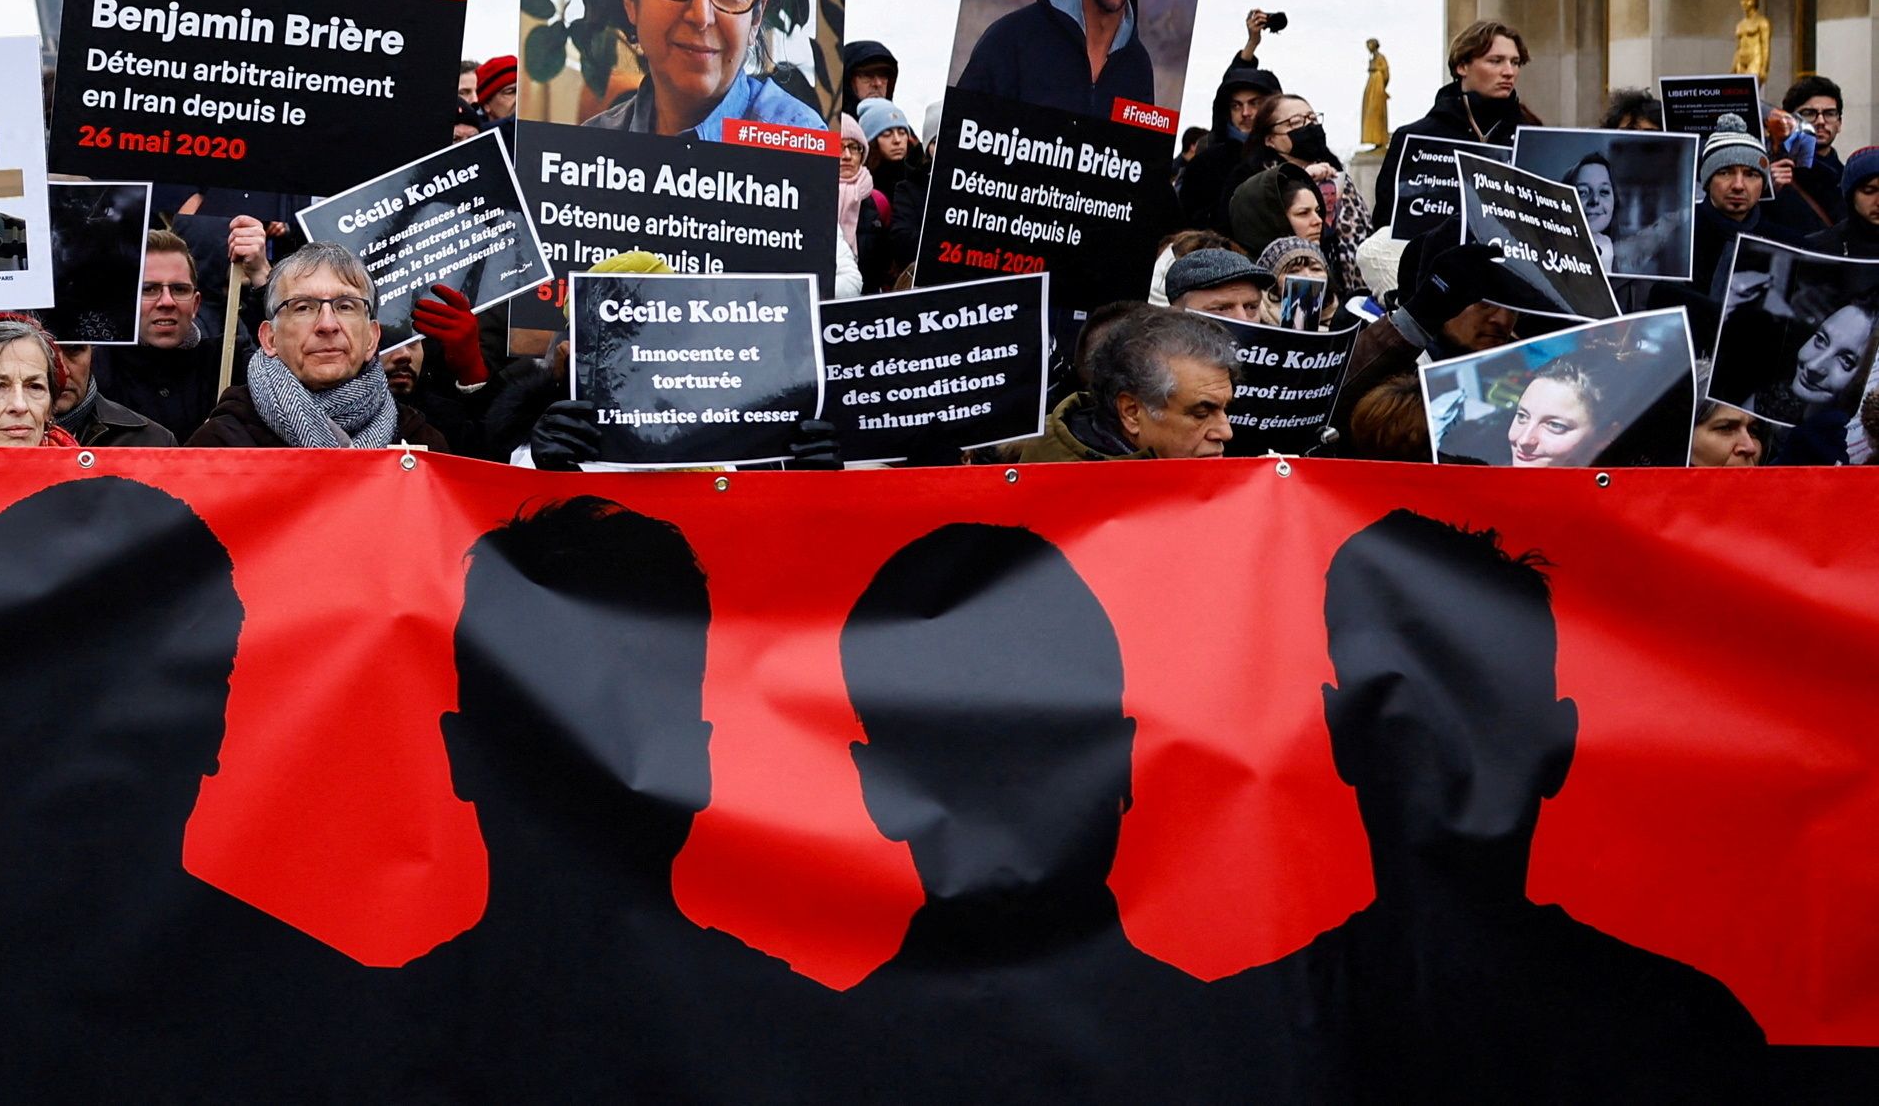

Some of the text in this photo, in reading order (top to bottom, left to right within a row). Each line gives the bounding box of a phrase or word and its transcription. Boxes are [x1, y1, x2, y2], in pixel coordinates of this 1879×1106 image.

[285, 14, 404, 54] Brière
[87, 49, 395, 98] Détenu arbitrairement
[83, 88, 305, 125] en Iran depuis le
[1123, 106, 1169, 128] #FreeBen
[80, 126, 246, 159] 26 mai 2020
[739, 126, 825, 151] #FreeFariba
[959, 119, 1141, 182] Benjamin Brière
[1412, 149, 1456, 163] Innocen
[542, 152, 798, 209] Fariba Adelkhah
[951, 168, 1132, 221] Détenu arbitrairement
[1408, 174, 1459, 187] L'injustic
[1473, 173, 1501, 190] Plus
[1504, 181, 1514, 194] de
[1534, 191, 1559, 209] jours
[1562, 200, 1572, 213] de
[338, 164, 483, 233] Cécile Kohler
[1410, 198, 1454, 215] Cécile
[369, 237, 387, 255] Les
[390, 209, 459, 248] souffrances
[458, 200, 471, 215] de
[473, 196, 485, 208] la
[541, 202, 803, 250] Détenue arbitrairement
[946, 207, 1081, 245] en Iran depuis le
[1481, 202, 1516, 219] prison
[1519, 213, 1540, 226] sans
[1543, 219, 1572, 235] raison
[367, 208, 504, 272] urnée où entrent la faim,
[411, 261, 422, 271] le
[424, 244, 457, 265] froid,
[459, 239, 470, 249] la
[471, 221, 515, 246] fatigue,
[380, 285, 408, 306] peur
[410, 277, 423, 289] et
[424, 272, 436, 283] la
[435, 238, 509, 280] promiscuité
[542, 241, 567, 261] en
[706, 253, 723, 273] le
[939, 242, 1044, 273] 26 mai 2020
[1542, 249, 1592, 275] Kohler
[599, 299, 788, 322] Cécile Kohler
[823, 304, 1018, 343] Cécile Kohler
[632, 346, 760, 361] Innocente et
[826, 344, 1018, 380] Est détenue dans
[1232, 346, 1346, 369] cile Kohler
[652, 372, 741, 388] torturée
[843, 373, 1005, 405] des conditions
[1234, 384, 1333, 400] prof investie
[598, 408, 799, 427] L'injustice doit cesser
[859, 402, 991, 429] inhumaines
[1229, 414, 1324, 430] mie généreuse
